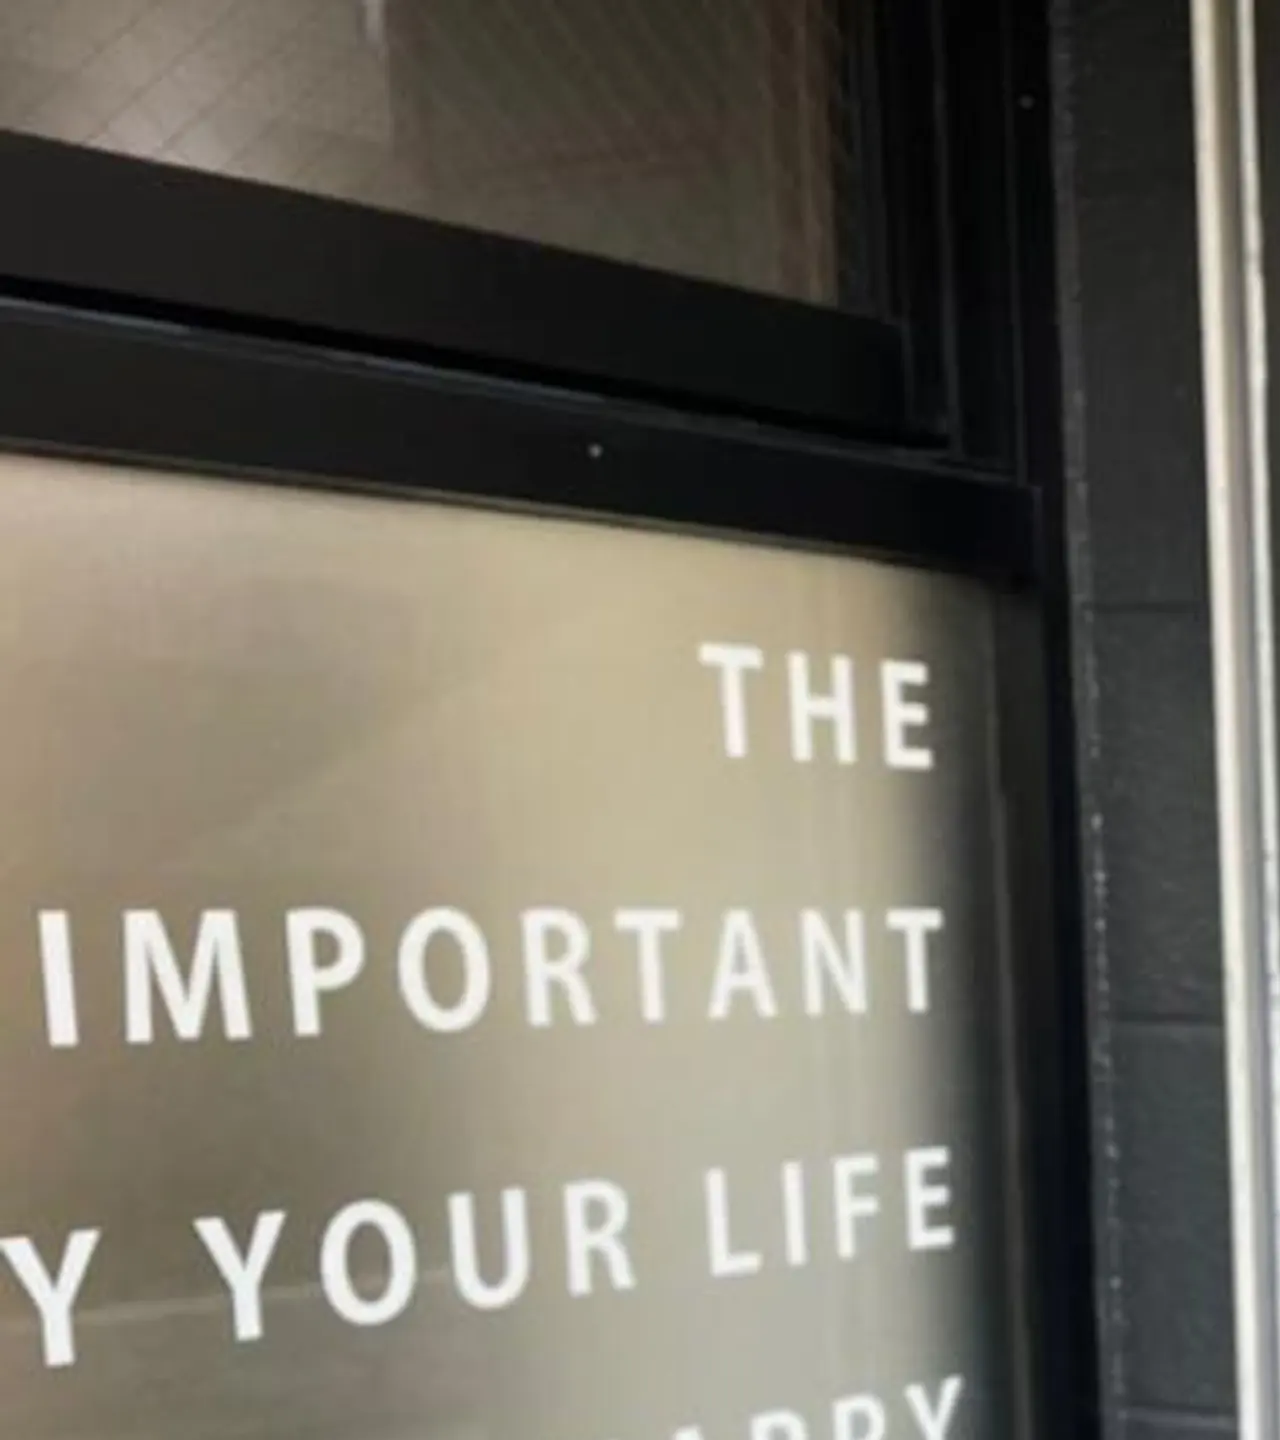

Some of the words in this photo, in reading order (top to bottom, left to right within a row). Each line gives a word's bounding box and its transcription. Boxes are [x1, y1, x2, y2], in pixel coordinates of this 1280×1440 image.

[697, 641, 935, 769] THE
[37, 906, 943, 1047] IMPORTANT
[194, 1178, 637, 1342] YOUR
[700, 1146, 955, 1279] LIFE
